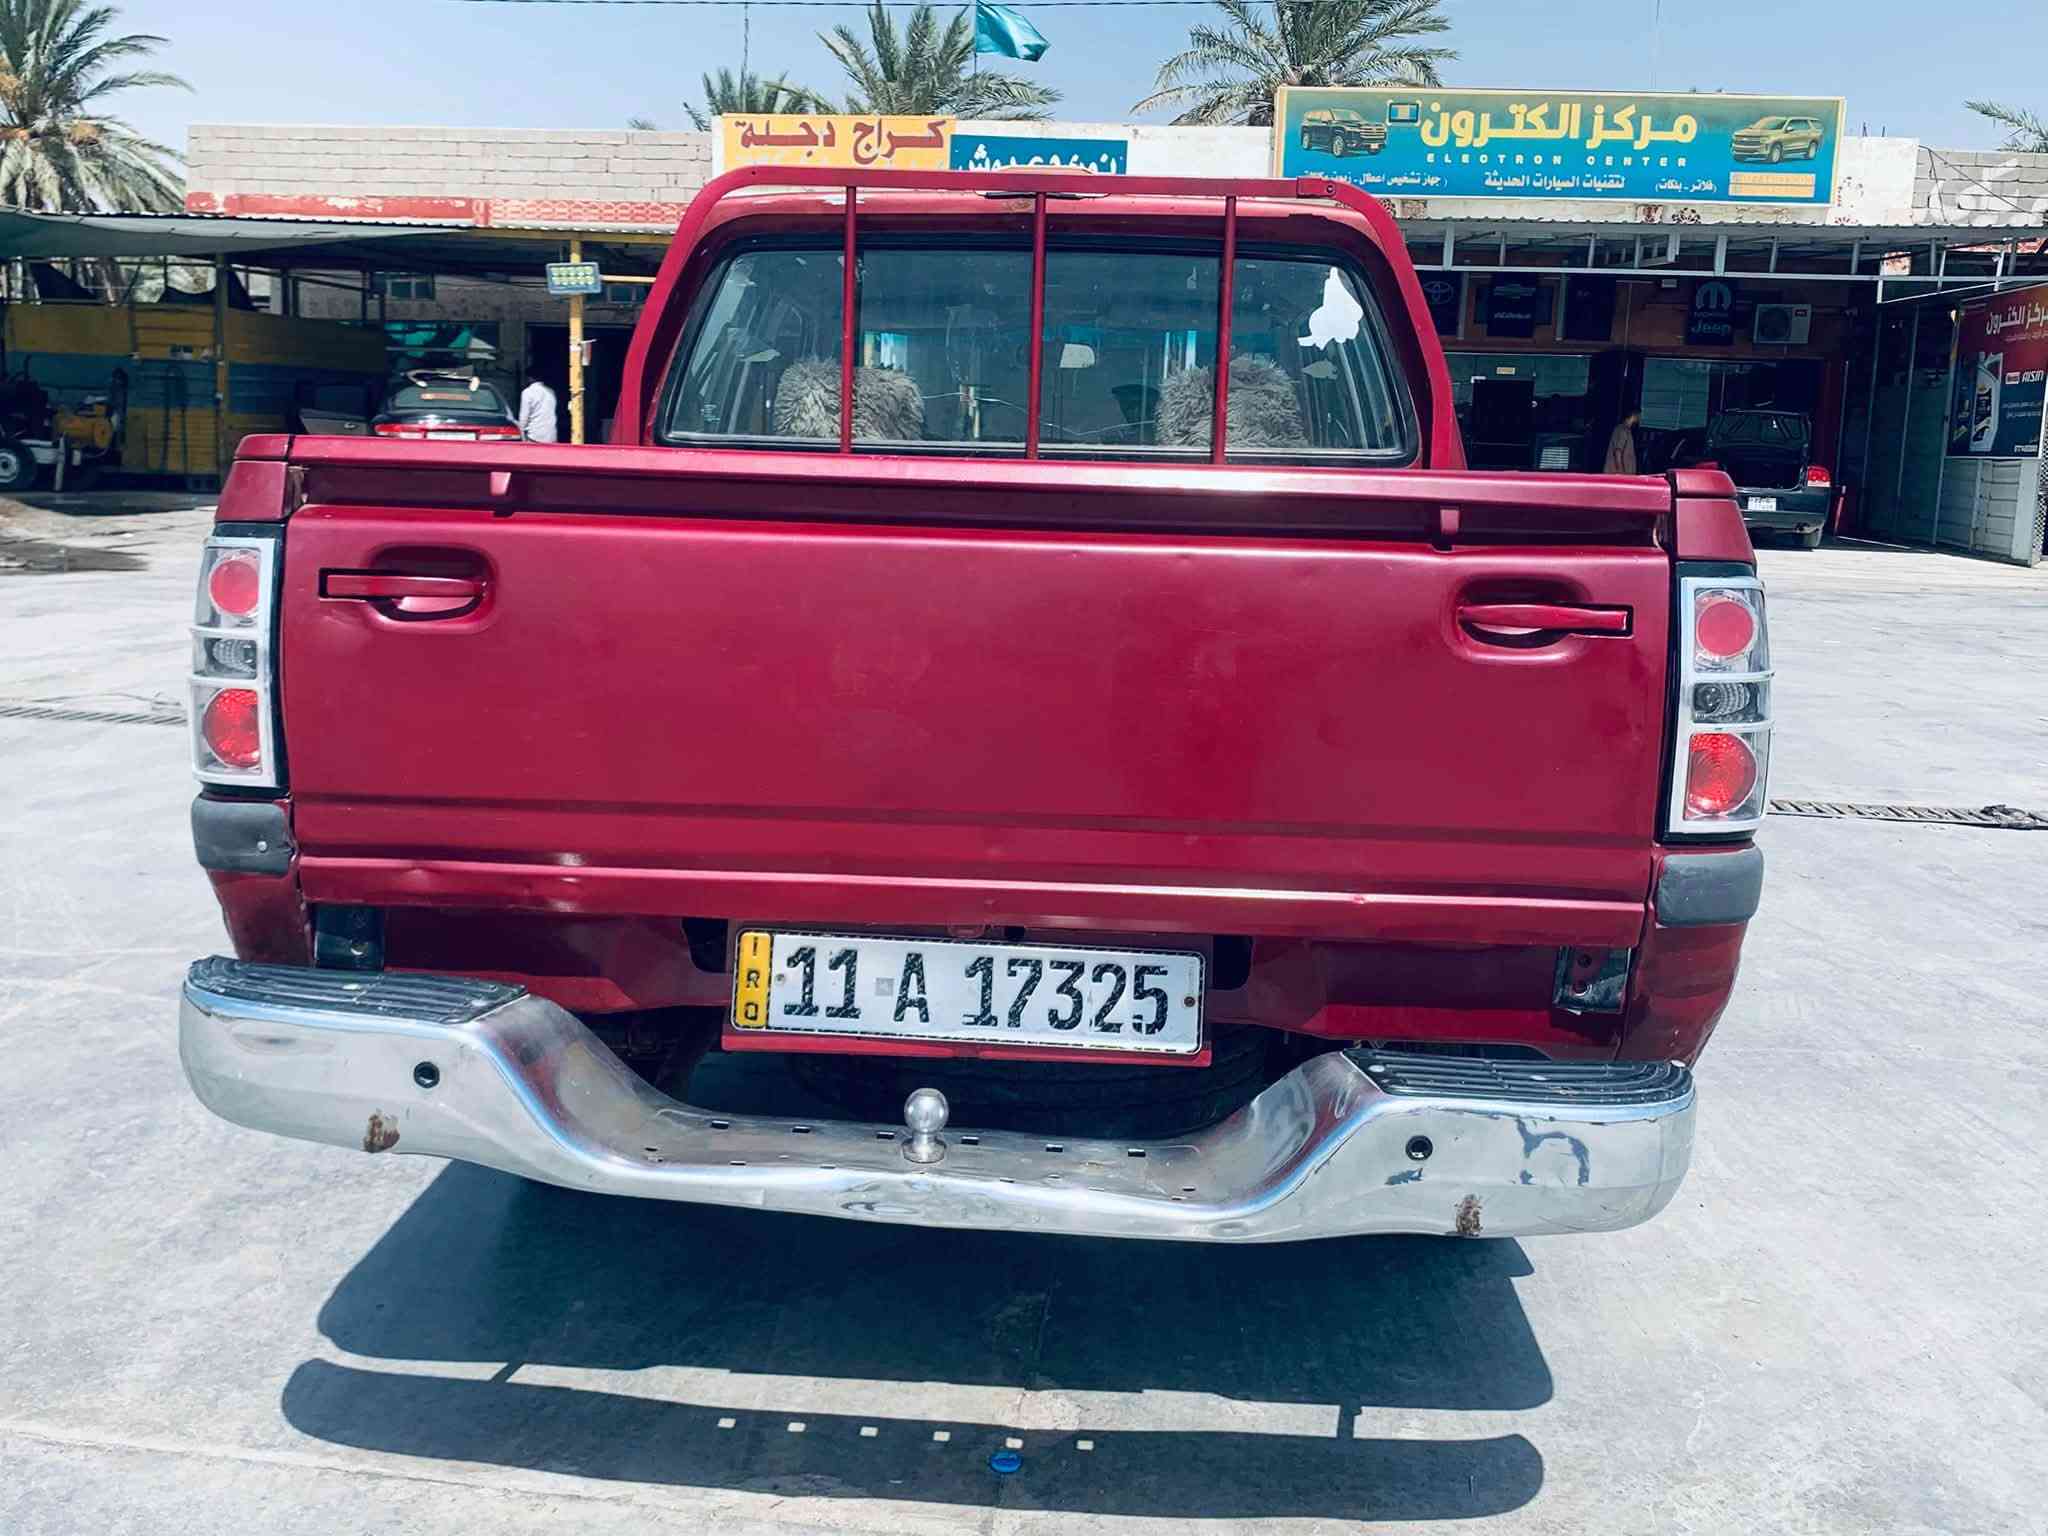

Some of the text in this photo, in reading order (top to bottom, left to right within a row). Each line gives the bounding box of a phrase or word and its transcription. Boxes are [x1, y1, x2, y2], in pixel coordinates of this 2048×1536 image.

[734, 119, 836, 157] دجلة
[852, 118, 946, 165] كراج
[1420, 102, 1698, 149] مركز الكترون
[1387, 171, 1421, 186] تشخيص
[1426, 153, 1688, 168] ELECTRON CENTER
[1484, 169, 1626, 191] لتقنيات السيارات الحديثة
[783, 946, 1169, 1036] 11 A 17325
